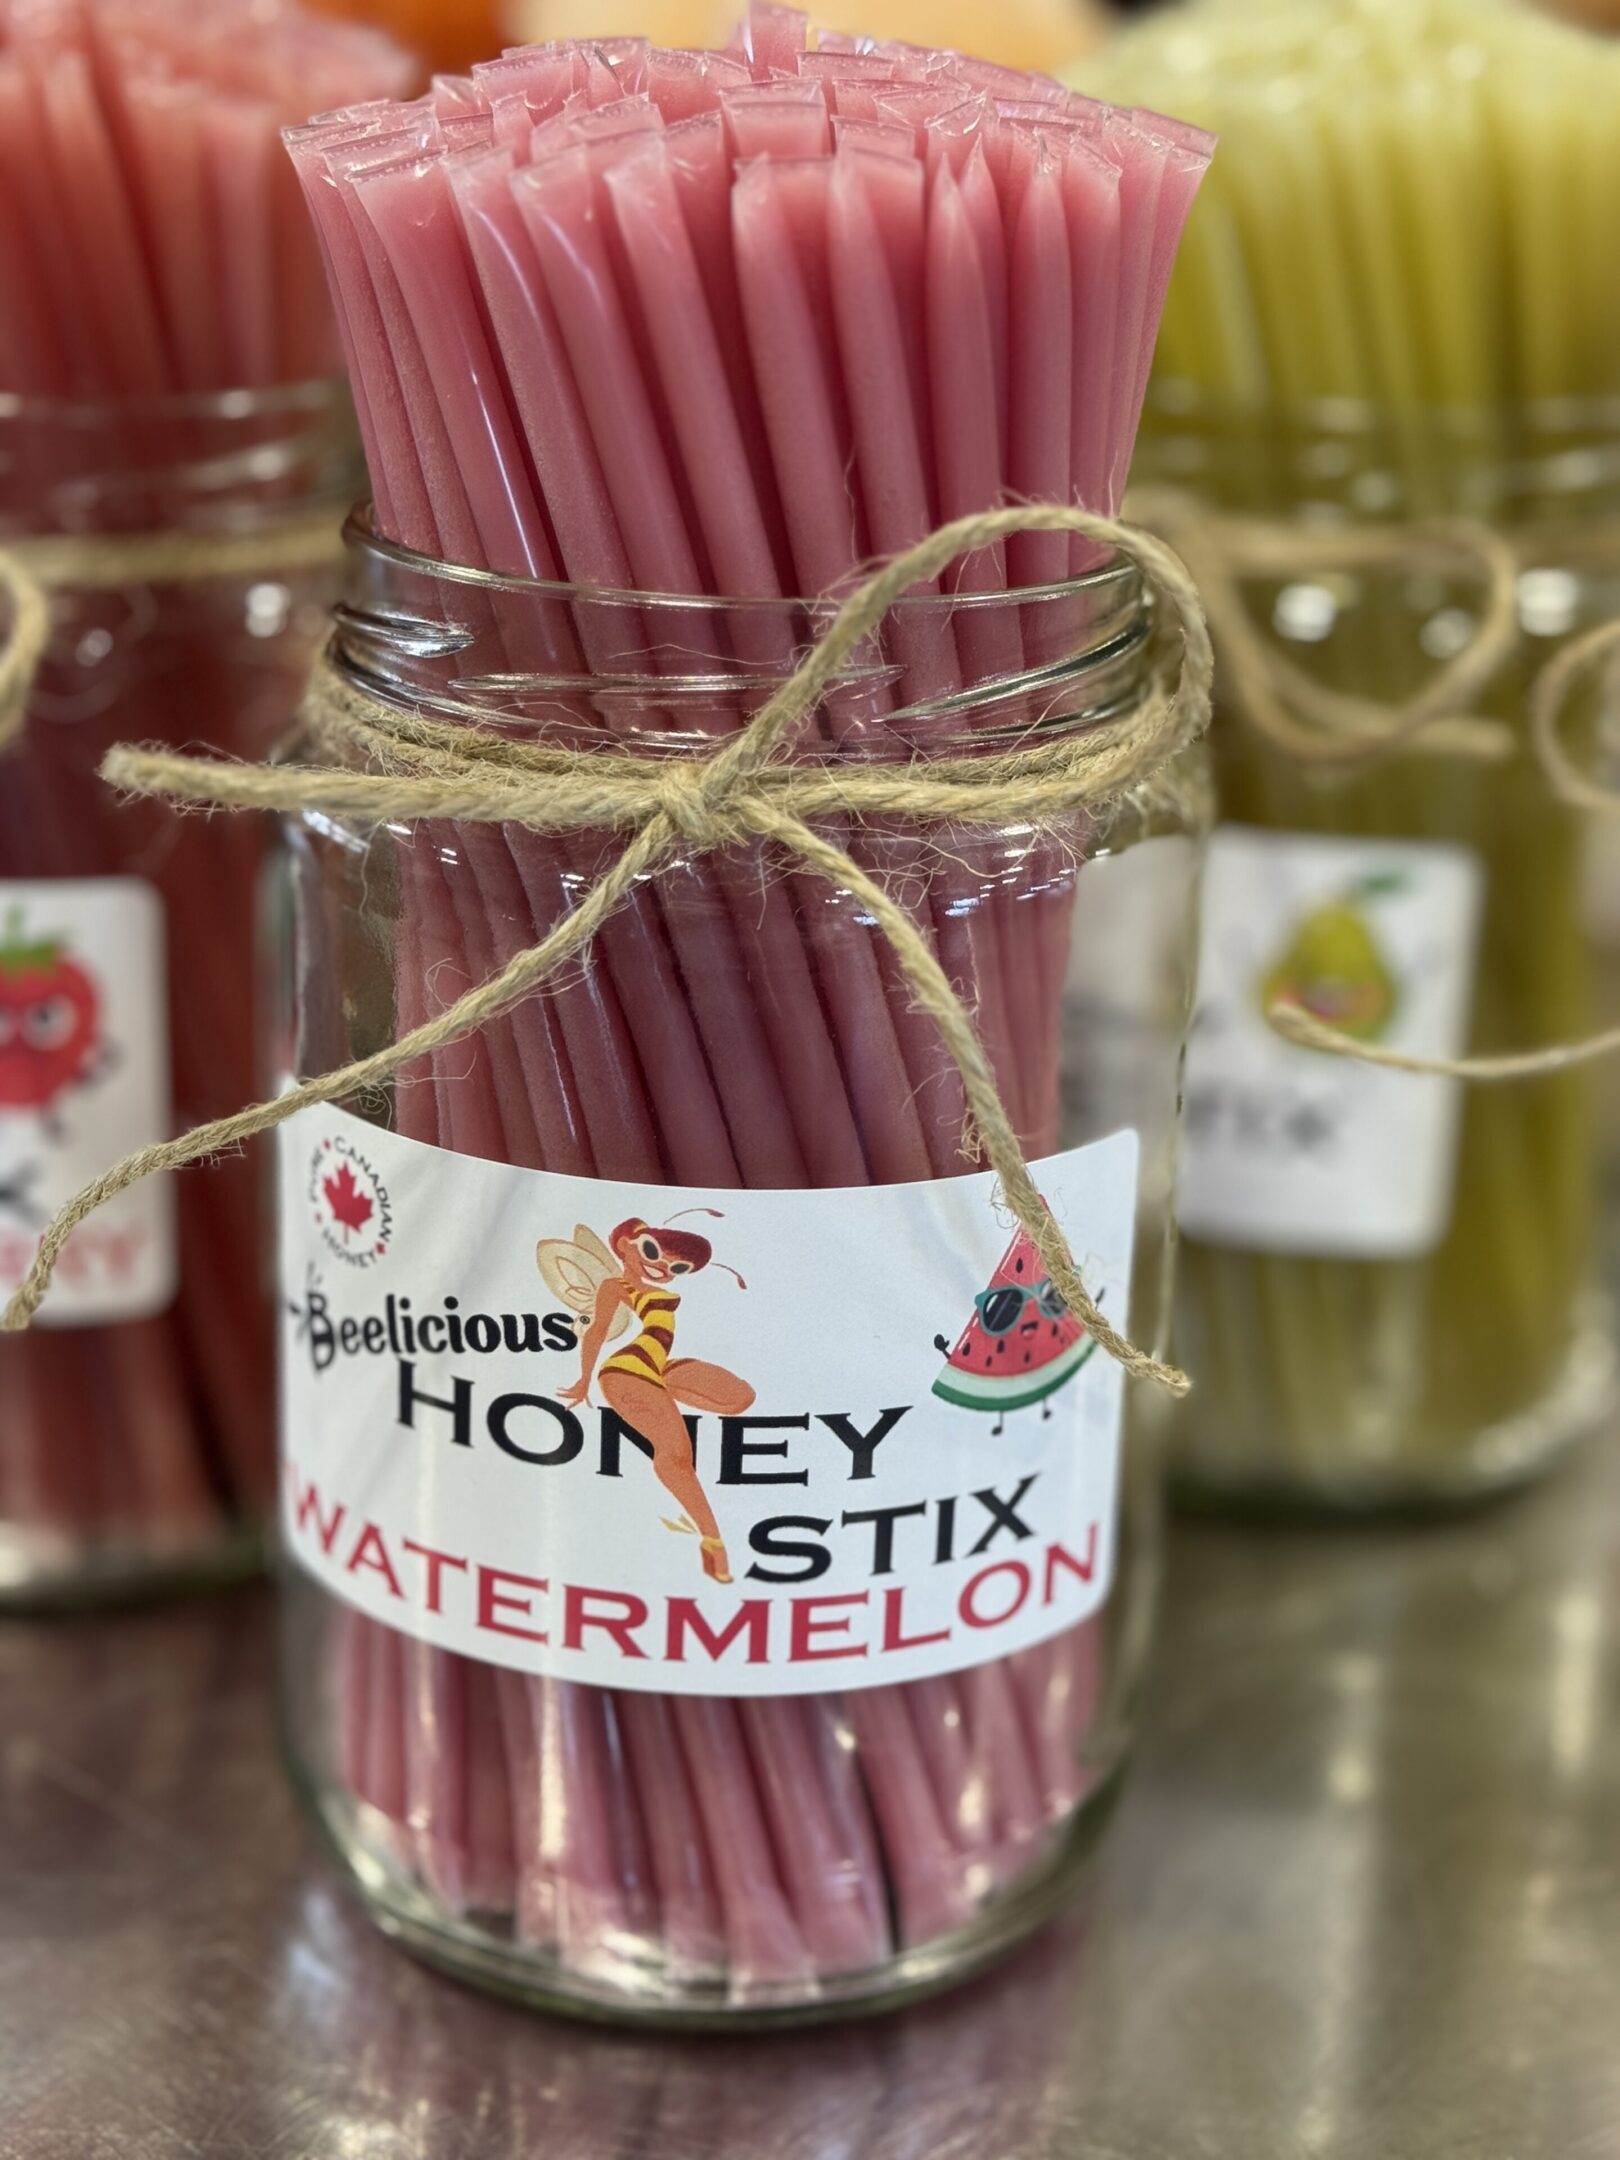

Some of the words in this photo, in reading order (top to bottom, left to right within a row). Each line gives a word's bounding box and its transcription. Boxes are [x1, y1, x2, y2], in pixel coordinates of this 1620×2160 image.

[334, 1136, 393, 1243] CANADIAN
[396, 1358, 914, 1487] HONEY
[286, 1462, 1098, 1664] WATERMELON
[744, 1471, 1042, 1584] STIX
